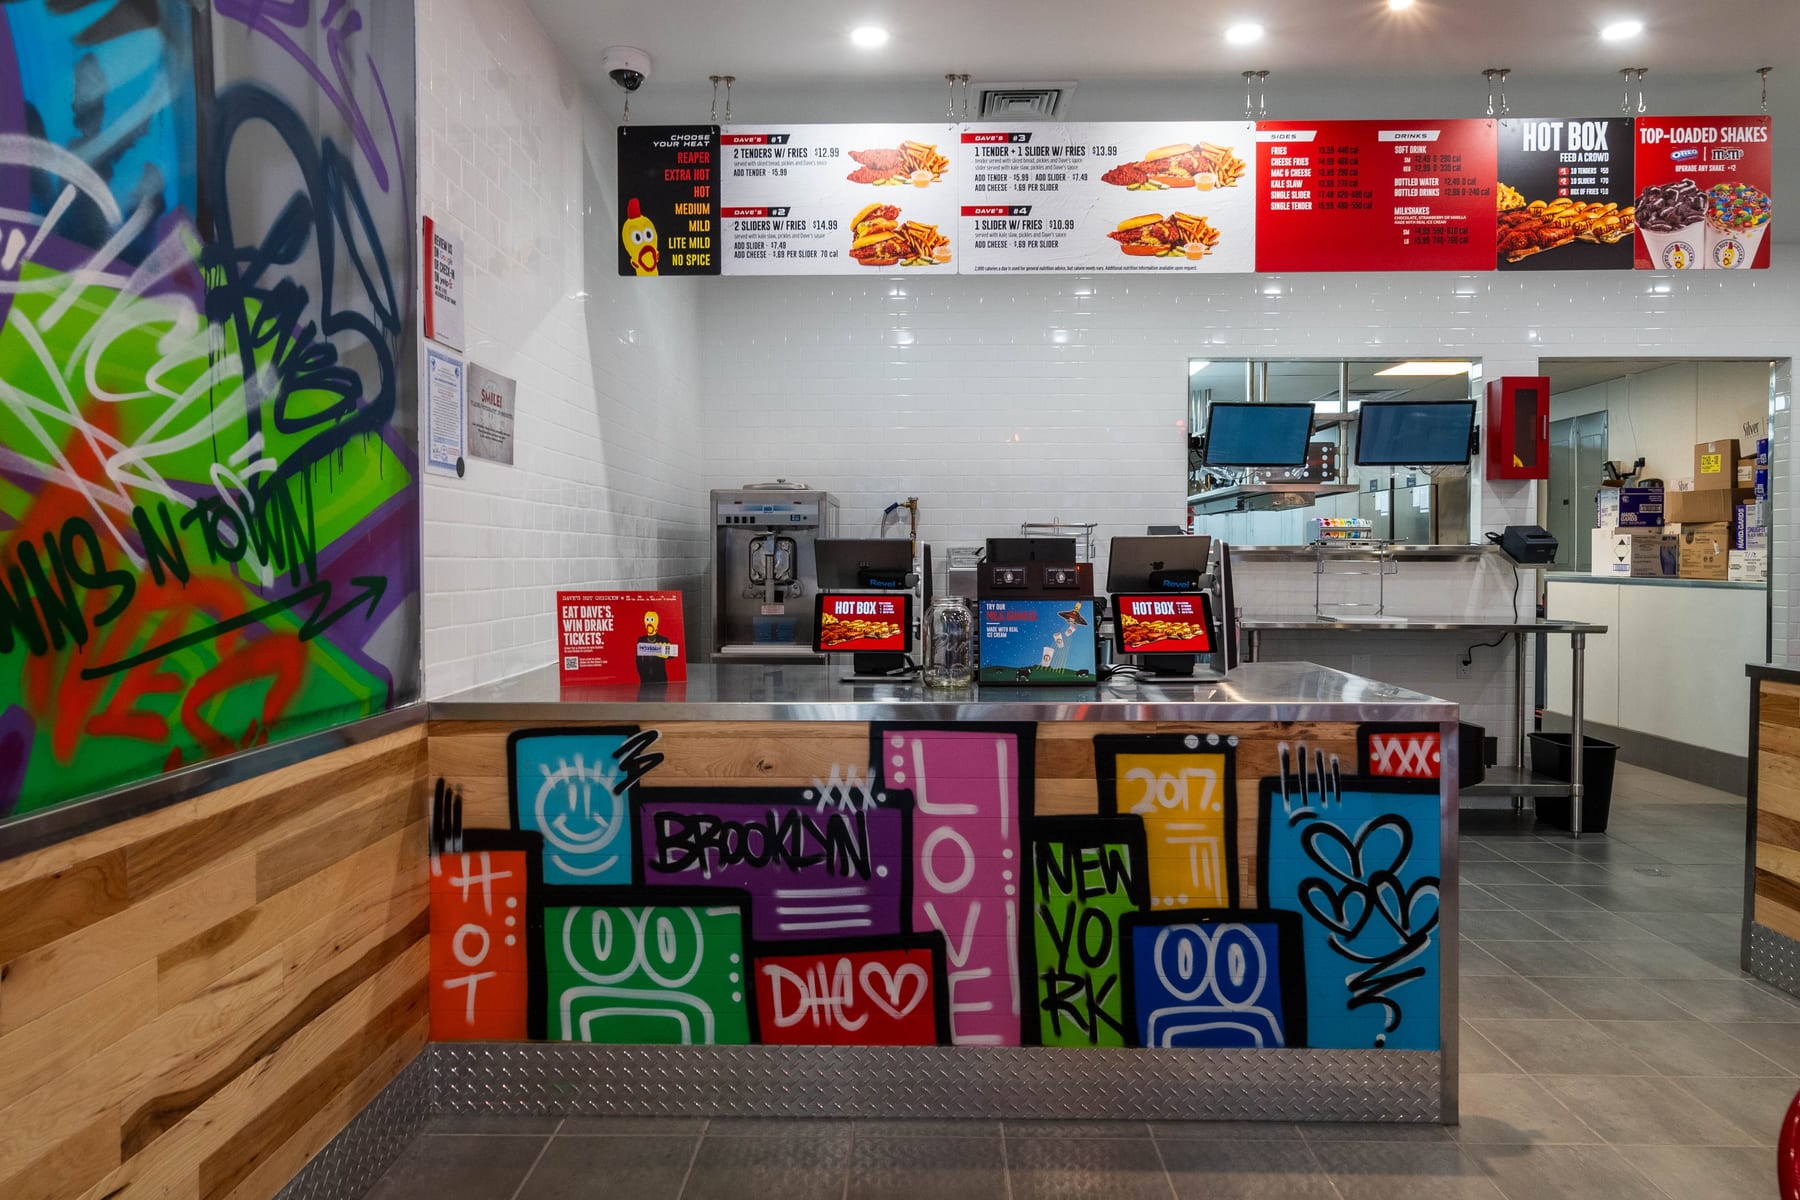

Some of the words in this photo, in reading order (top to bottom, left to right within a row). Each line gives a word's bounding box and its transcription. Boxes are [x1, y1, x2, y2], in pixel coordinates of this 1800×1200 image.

[1523, 122, 1563, 151] HOT
[1568, 122, 1609, 151] BOX
[1640, 127, 1718, 144] TOP-LOADED
[1720, 126, 1768, 143] SHAKES
[734, 148, 739, 158] 2
[741, 148, 772, 158] TENDERS
[774, 148, 785, 158] W/
[787, 148, 808, 158] FRIES
[814, 148, 840, 158] $12.99
[975, 147, 979, 156] 1
[982, 147, 1009, 156] TENDER
[1018, 147, 1022, 156] 1
[1024, 147, 1050, 156] SLIDER
[1052, 147, 1063, 156] W/
[1065, 146, 1086, 156] FRIES
[1092, 146, 1118, 156] $13.99
[1271, 146, 1287, 155] FRIES
[1394, 146, 1409, 154] SOFT
[1409, 146, 1427, 154] DRINK
[677, 152, 710, 164] REAPER
[1271, 158, 1292, 166] CHEESE
[1293, 158, 1309, 166] FRIES
[1560, 153, 1577, 162] FEED
[1578, 153, 1583, 162] A
[1584, 152, 1609, 162] CROWD
[664, 169, 691, 181] EXTRA
[694, 169, 710, 181] HOT
[733, 168, 744, 176] ADD
[746, 168, 766, 176] TENDER
[772, 168, 787, 176] $5.99
[1271, 169, 1284, 177] MAC
[1290, 169, 1312, 177] CHEESE
[1271, 180, 1285, 188] KALE
[1286, 180, 1303, 188] SLAW
[1394, 178, 1418, 186] BOTTLED
[1419, 178, 1440, 186] WATER
[694, 186, 710, 198] HOT
[974, 184, 986, 192] ADD
[987, 184, 1008, 192] CHEESE
[1027, 184, 1038, 192] PER
[1394, 188, 1418, 197] BOTTLED
[1419, 188, 1440, 197] DRINKS
[1270, 191, 1290, 199] SINGLE
[1291, 191, 1311, 199] SLIDER
[675, 203, 710, 215] MEDIUM
[1270, 202, 1290, 210] SINGLE
[1291, 202, 1312, 210] TENDER
[1394, 207, 1430, 215] MILKSHAKES
[688, 220, 710, 232] MILD
[734, 220, 740, 231] 2
[741, 220, 770, 231] SLIDERS
[772, 220, 783, 231] W/
[786, 220, 806, 231] FRIES
[813, 220, 838, 231] $14.99
[975, 220, 980, 230] 1
[982, 220, 1007, 230] SLIDER
[1009, 220, 1019, 230] W/
[1022, 220, 1042, 230] FRIES
[1049, 220, 1074, 230] $10.99
[668, 237, 686, 249] LITE
[688, 237, 710, 249] MILD
[734, 242, 745, 250] ADD
[746, 242, 765, 250] SLIDER
[771, 242, 786, 250] $7.49
[975, 240, 986, 248] ADD
[987, 240, 1008, 248] CHEESE
[1028, 240, 1038, 248] PER
[1040, 240, 1059, 248] SLIDER
[734, 250, 745, 258] ADD
[746, 250, 767, 258] CHEESE
[786, 250, 797, 258] PER
[799, 250, 818, 258] SLIDER
[672, 254, 684, 266] NO
[686, 254, 710, 266] SPICE
[1742, 418, 1759, 435] Silver
[180, 470, 318, 588] TOWN
[869, 579, 896, 588] Revel
[1162, 580, 1190, 588] Revel
[562, 606, 579, 618] EAT
[581, 605, 614, 618] DAVE'S.
[835, 601, 855, 615] HOT
[856, 601, 876, 615] BOX
[1132, 602, 1152, 615] HOT
[1154, 602, 1175, 615] BOX
[562, 619, 582, 632] WIN
[584, 619, 614, 632] DRAKE
[1034, 842, 1133, 904] NEW
[912, 739, 1004, 1044] LOVE
[443, 853, 512, 1025] HOT
